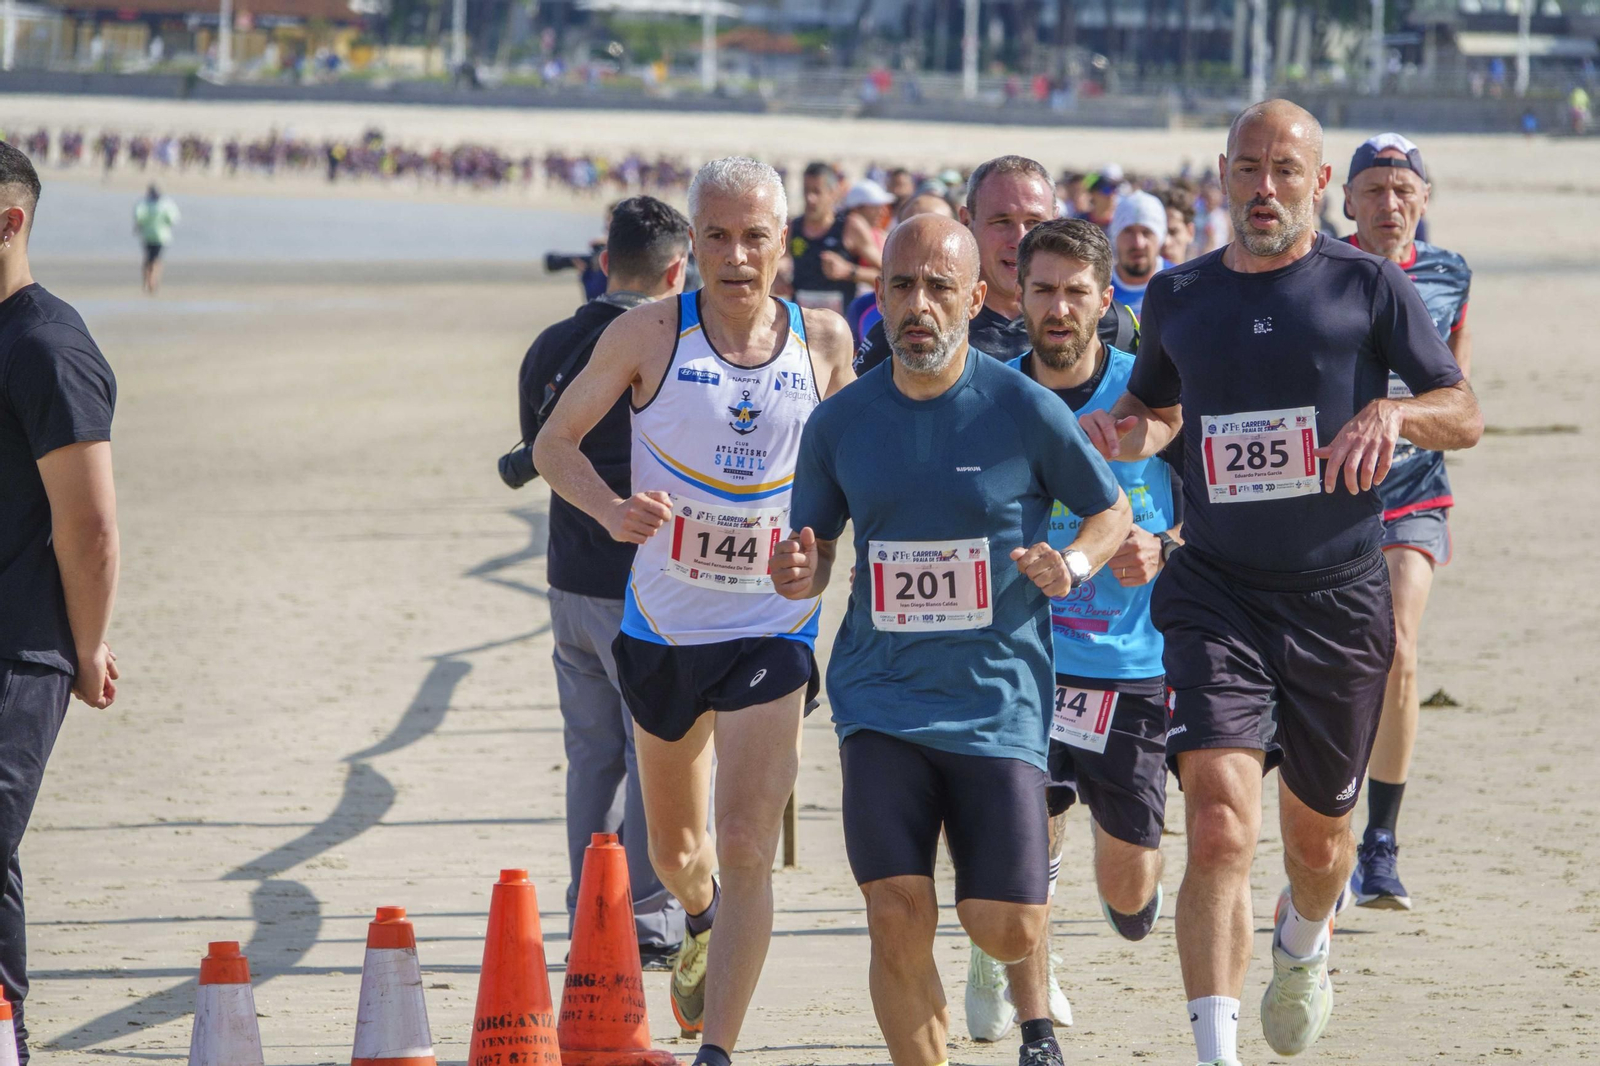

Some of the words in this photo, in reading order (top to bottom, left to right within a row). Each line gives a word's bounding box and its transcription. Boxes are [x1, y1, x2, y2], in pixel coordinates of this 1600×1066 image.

[1241, 419, 1270, 428] CARREIRA
[716, 445, 768, 458] ATLETISMO
[1224, 439, 1289, 471] 285
[715, 453, 765, 471] SAMIL
[717, 514, 748, 523] CARREIRA
[697, 532, 758, 563] 144
[711, 562, 736, 570] Fernandez
[895, 570, 956, 600] 201
[1085, 603, 1122, 616] Pereira
[508, 1052, 539, 1064] 877
